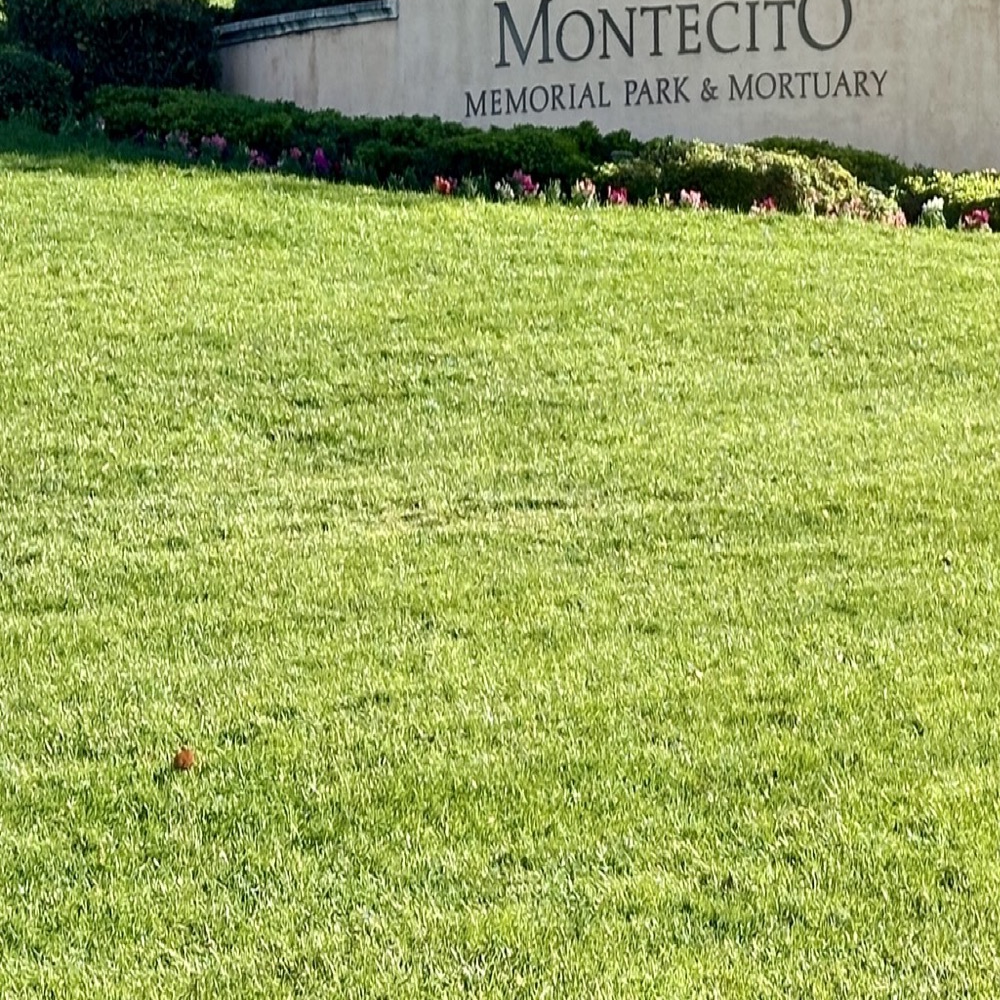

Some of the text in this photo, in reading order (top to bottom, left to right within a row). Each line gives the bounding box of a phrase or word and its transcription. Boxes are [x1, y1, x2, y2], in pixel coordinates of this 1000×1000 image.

[464, 69, 888, 118] MEMORIAL PARK & MORTUARY
